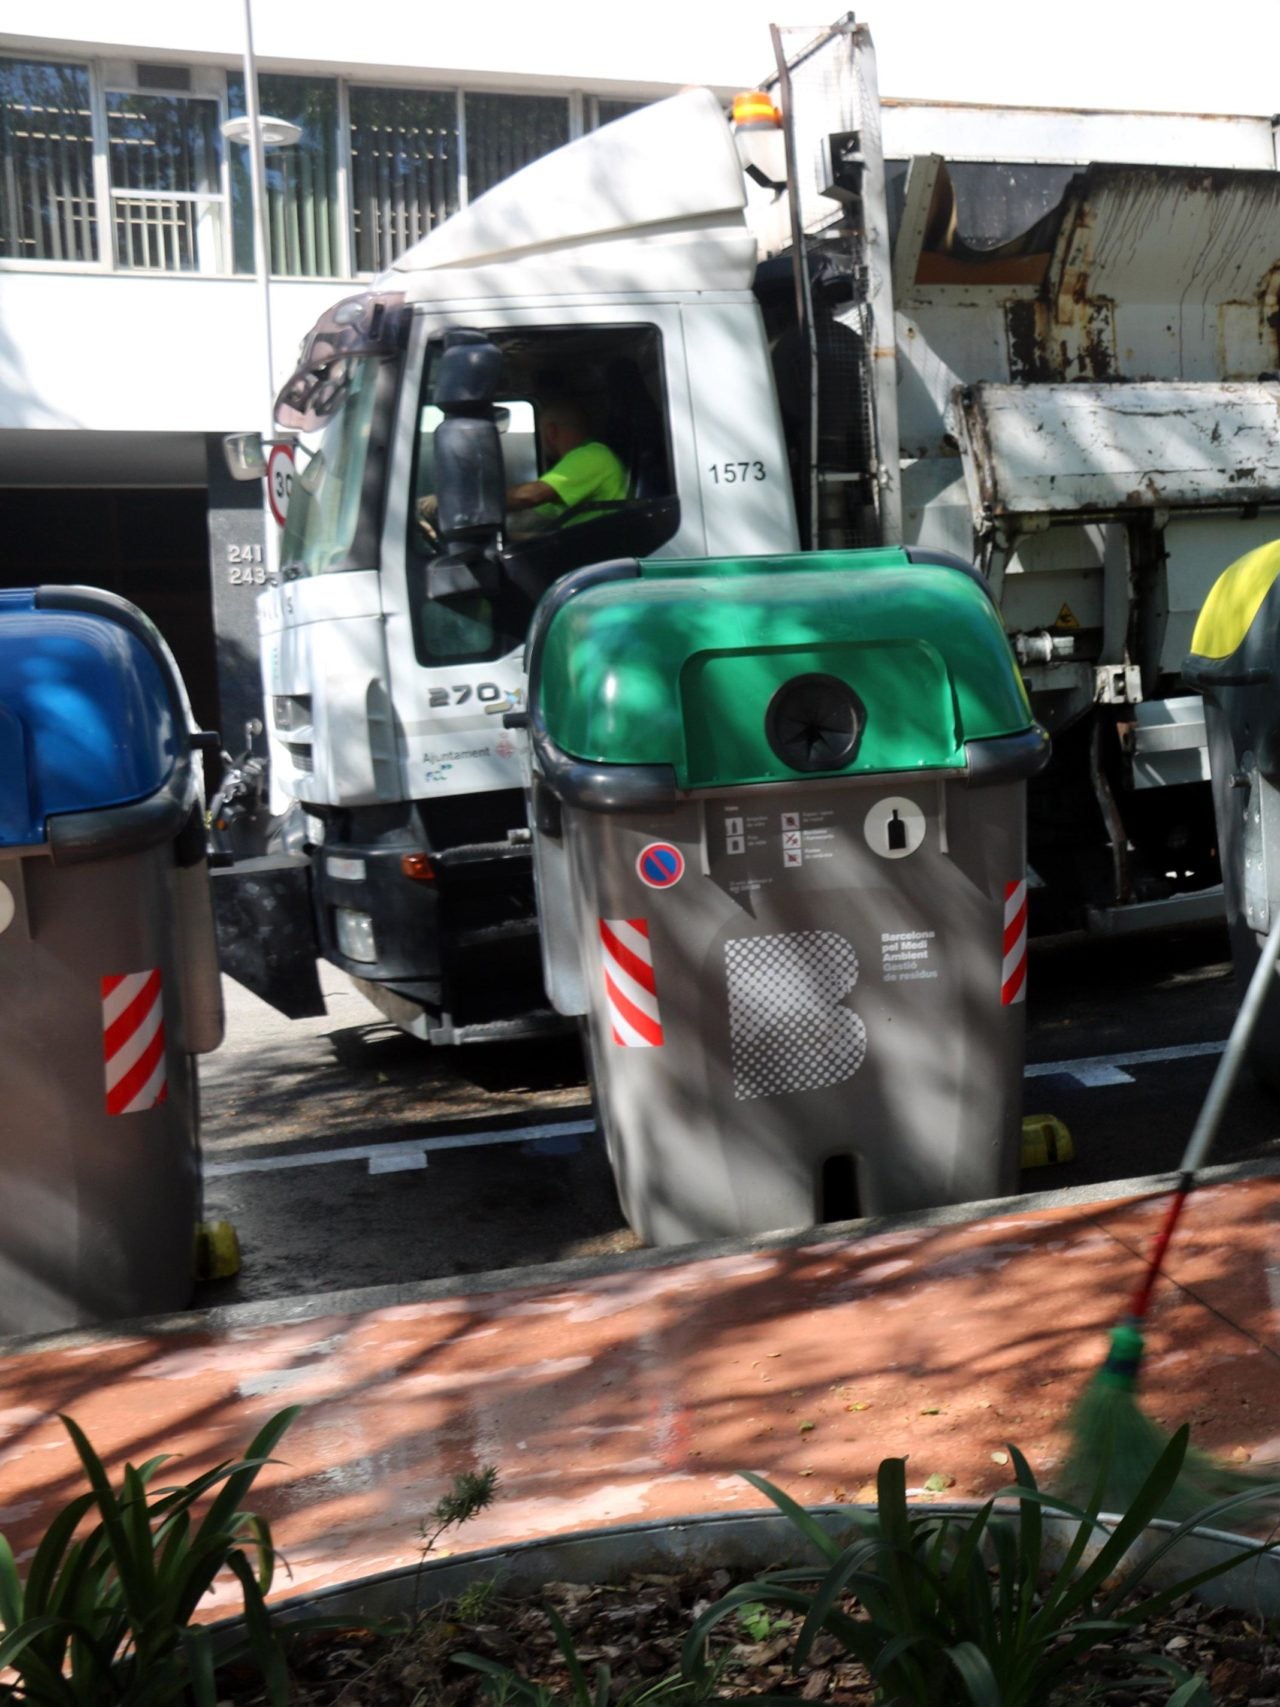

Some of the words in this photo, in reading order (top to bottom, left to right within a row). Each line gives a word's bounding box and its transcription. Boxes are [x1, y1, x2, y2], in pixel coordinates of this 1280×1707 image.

[709, 461, 767, 485] 1573
[275, 470, 293, 499] 30
[227, 544, 263, 564] 241
[229, 567, 267, 586] 243
[427, 682, 500, 708] 270
[423, 747, 491, 764] Ajuntament
[881, 931, 936, 943] Barcelona
[881, 942, 899, 954] pel
[900, 939, 928, 951] Medi
[882, 950, 929, 962] Ambient
[883, 960, 918, 972] Gestió
[883, 972, 897, 982] de
[899, 970, 938, 981] residus
